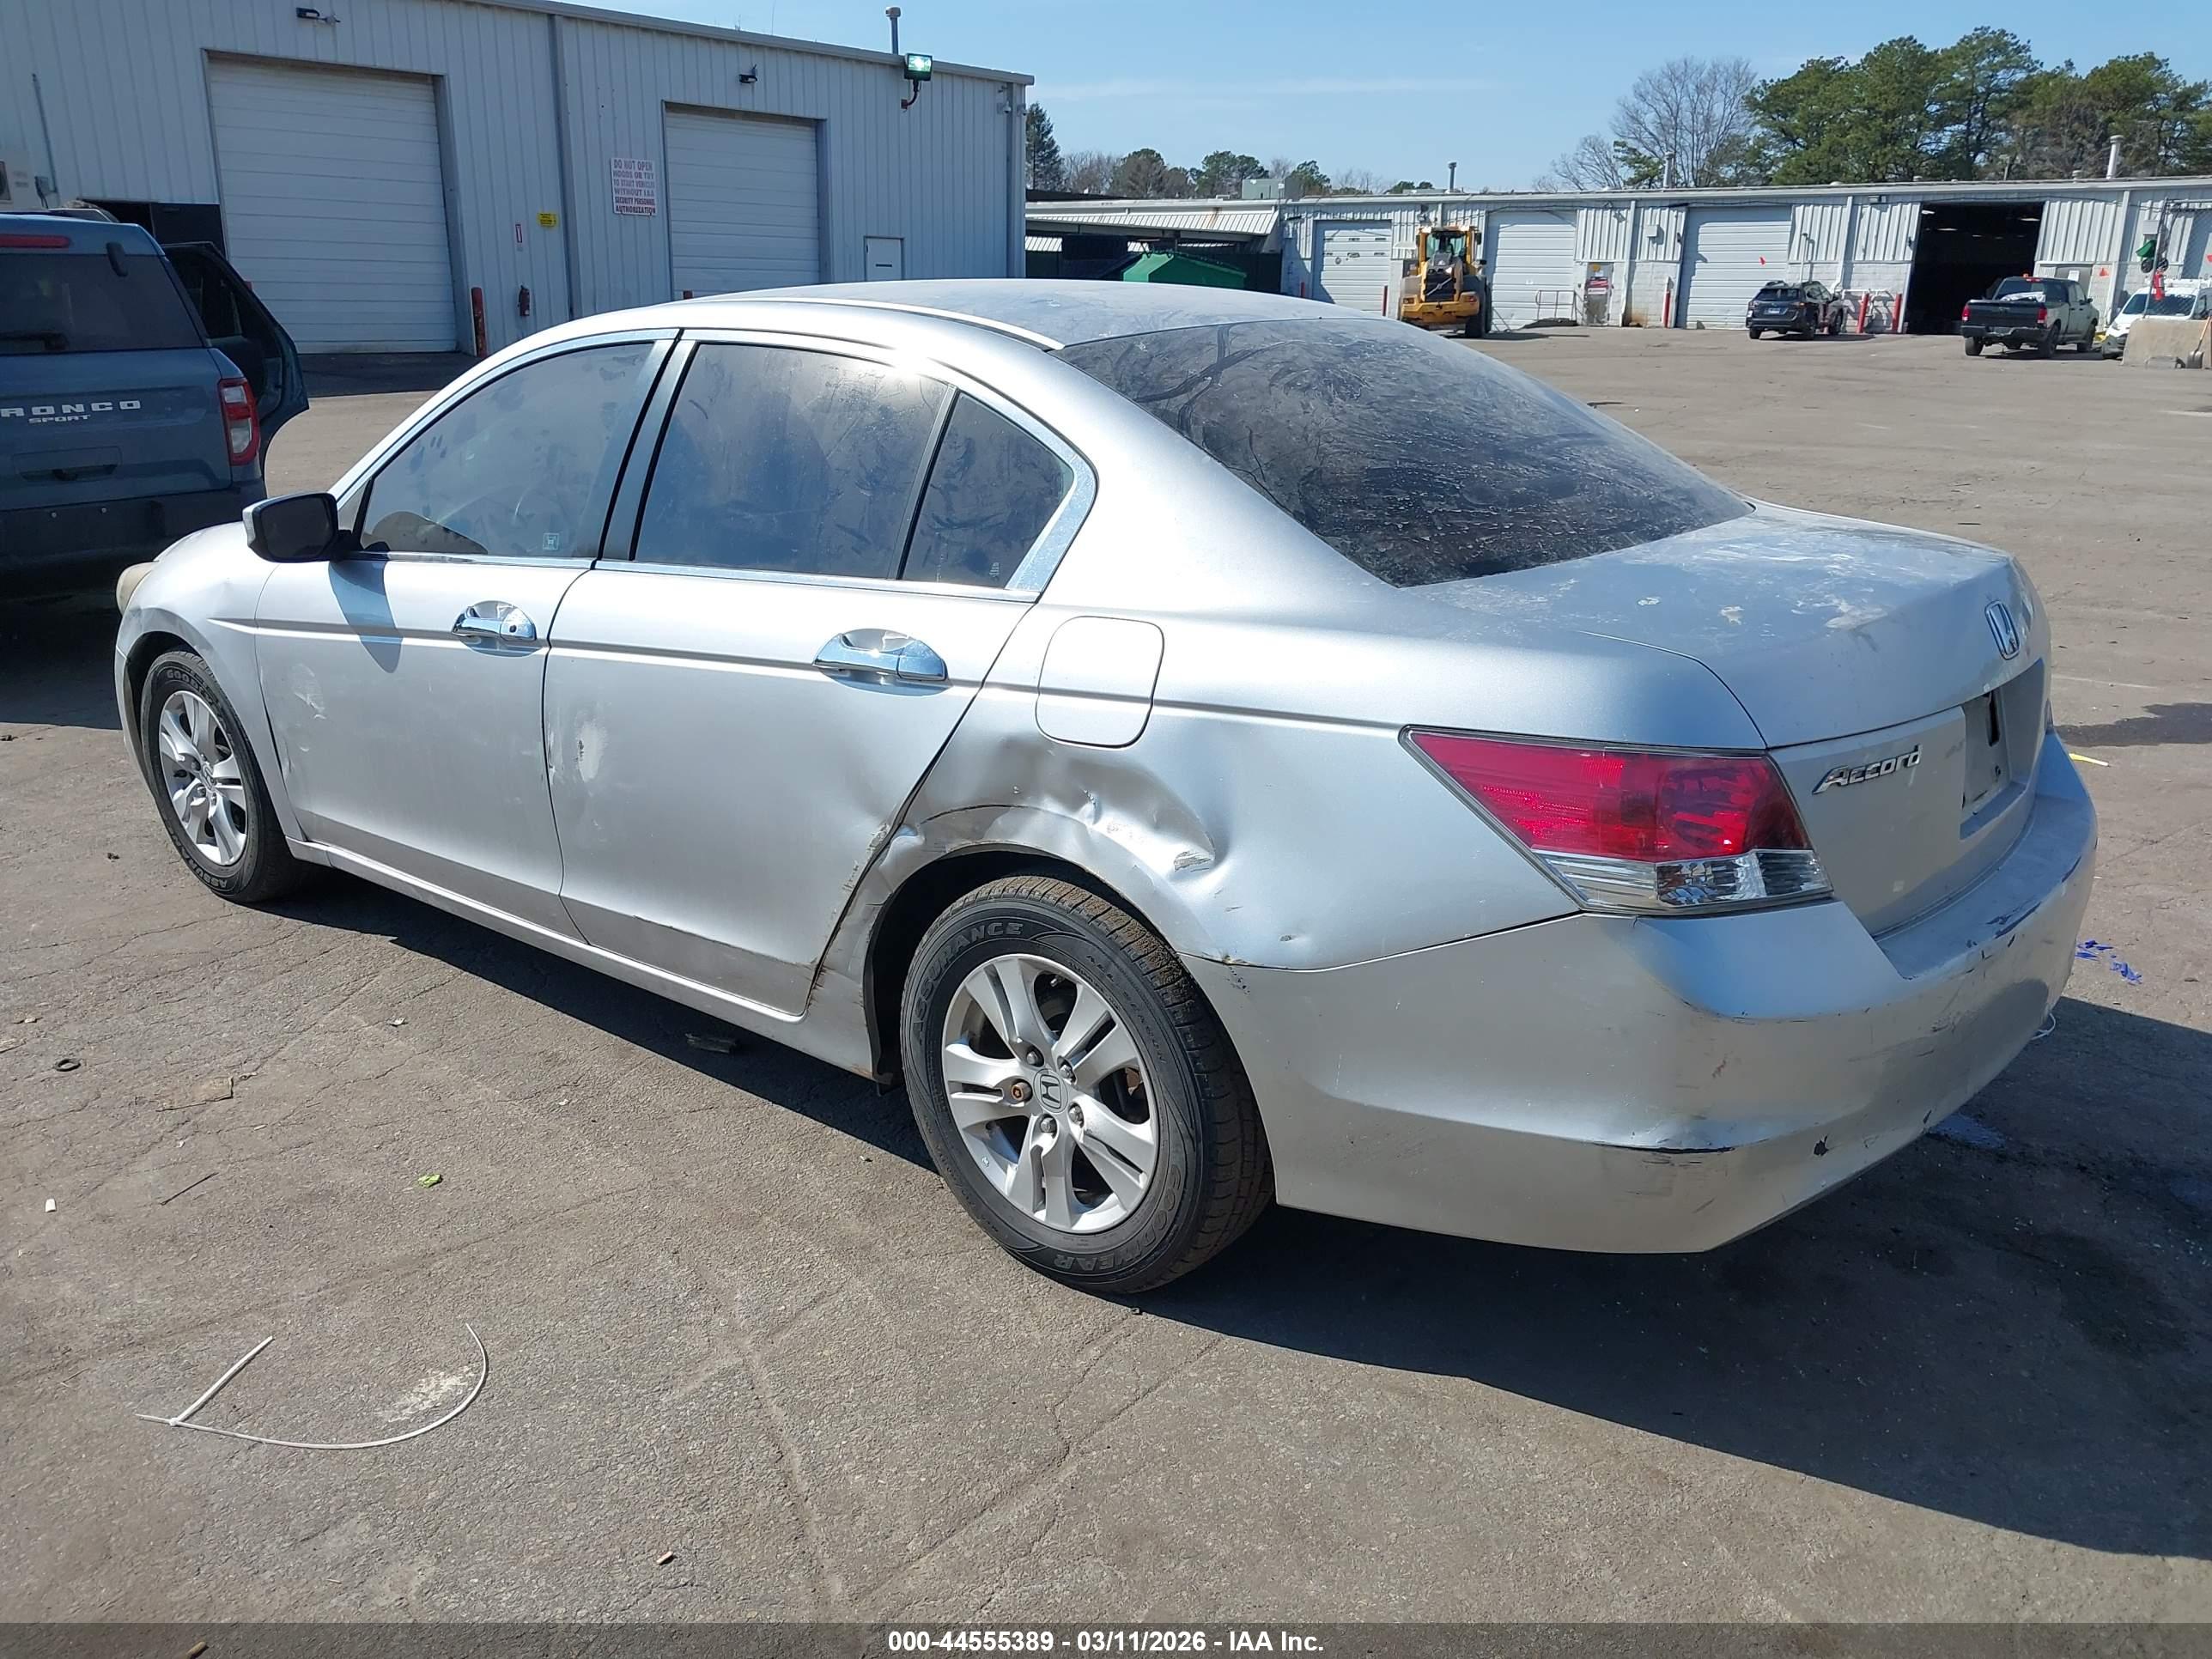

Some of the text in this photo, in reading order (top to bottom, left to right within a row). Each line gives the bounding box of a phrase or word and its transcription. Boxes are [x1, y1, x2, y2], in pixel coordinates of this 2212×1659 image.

[613, 159, 653, 171] DO NOT OPEN
[615, 197, 634, 205] SECURITY
[616, 205, 655, 214] AUTHORIZATION
[0, 400, 141, 417] RONCO
[28, 414, 91, 423] SPORT
[1812, 744, 1923, 795] Accord
